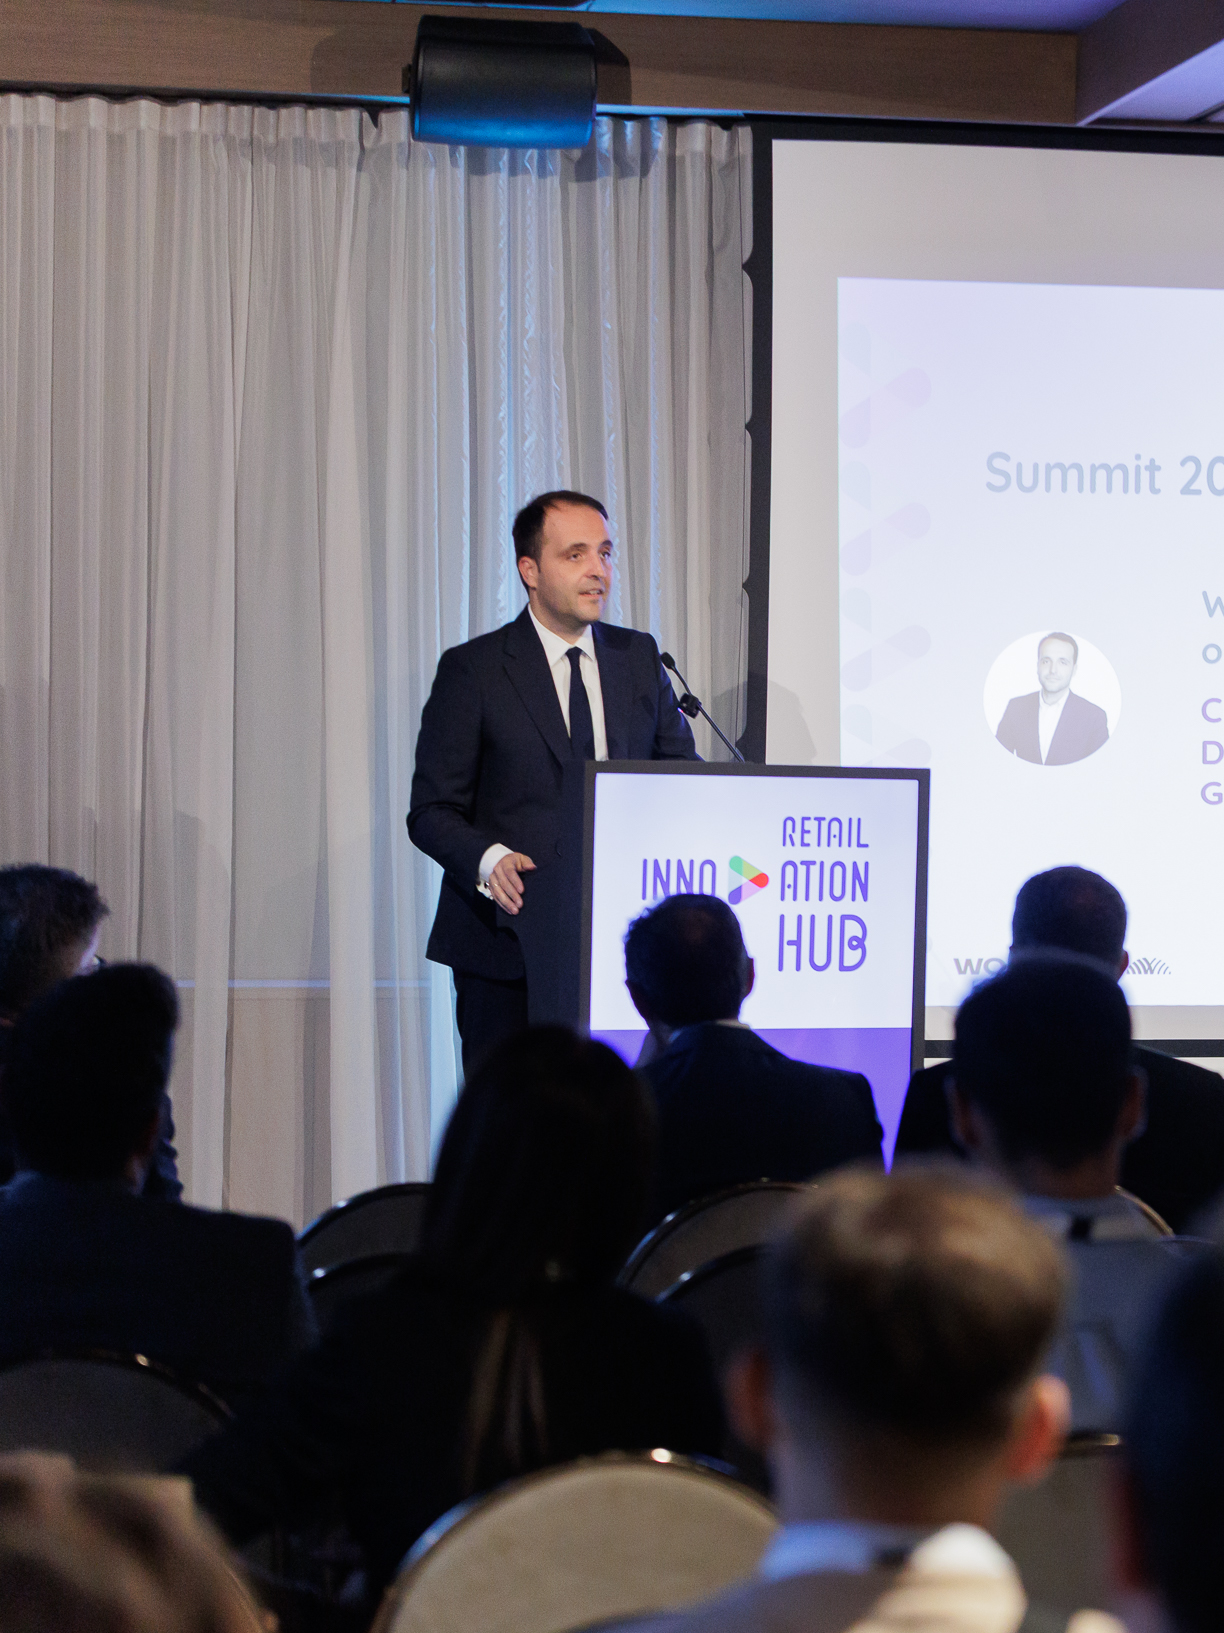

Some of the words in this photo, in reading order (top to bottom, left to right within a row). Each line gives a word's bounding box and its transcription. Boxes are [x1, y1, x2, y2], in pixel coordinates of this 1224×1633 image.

[985, 451, 1162, 496] Summit
[782, 816, 870, 849] RETAIL
[641, 858, 717, 901] INNO
[780, 859, 870, 903] ATION
[777, 913, 868, 973] HUB
